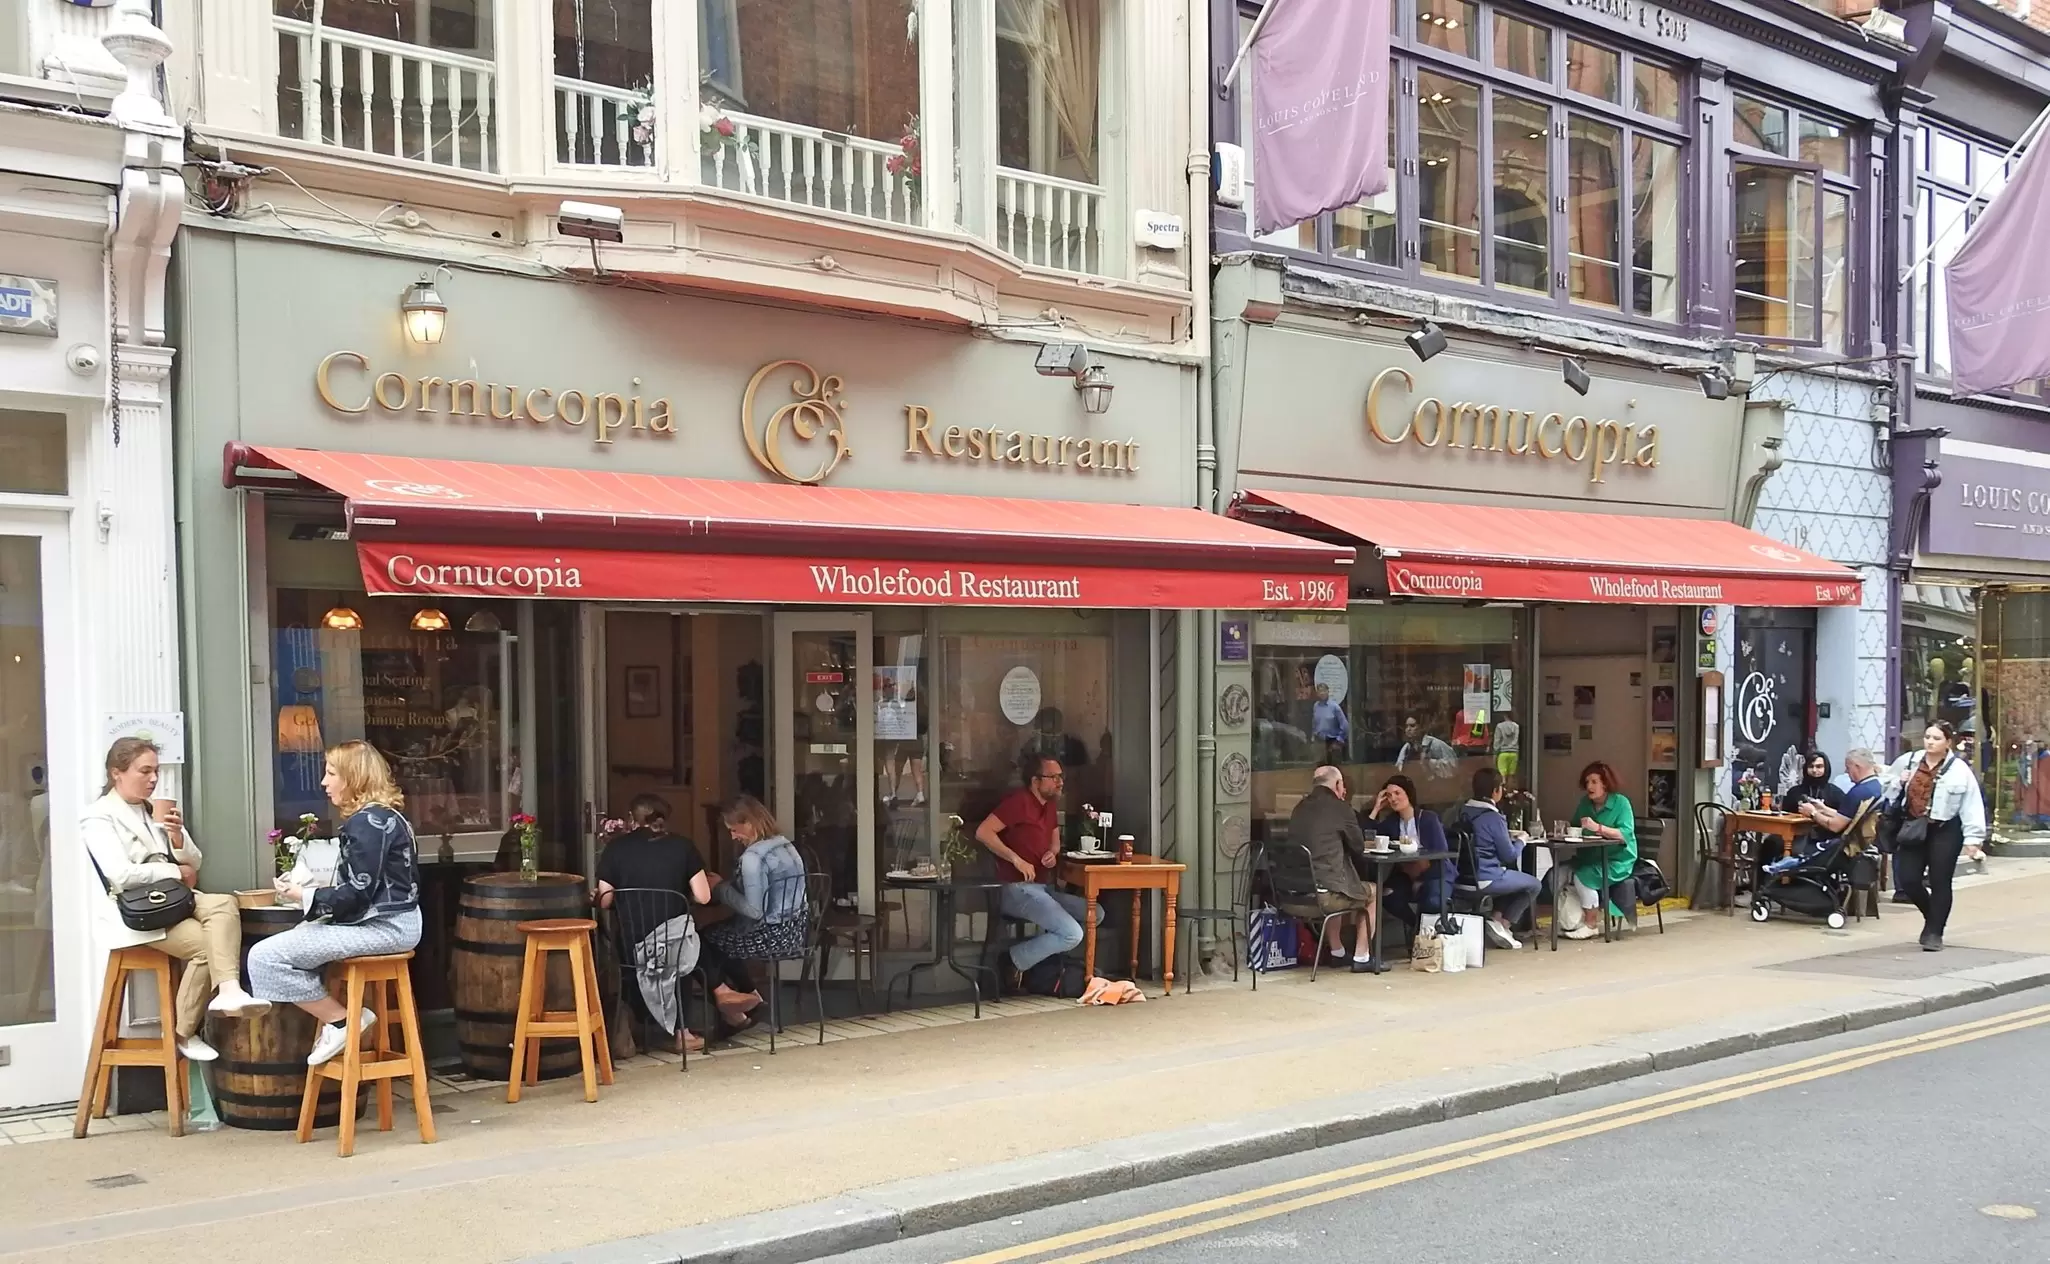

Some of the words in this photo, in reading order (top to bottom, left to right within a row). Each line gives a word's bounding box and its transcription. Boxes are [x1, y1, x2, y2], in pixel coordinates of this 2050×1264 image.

[1259, 106, 1299, 129] LOUIS
[1147, 221, 1180, 233] Spectra
[0, 292, 32, 313] ADT
[316, 350, 679, 444] Cornucopia
[904, 403, 1141, 472] Restaurant
[1366, 366, 1661, 484] Cornucopia
[1961, 483, 2022, 512] LOUIS
[1793, 525, 1808, 549] 19
[2022, 523, 2043, 535] AND
[387, 555, 582, 596] Cornucopia
[809, 566, 953, 597] Wholefood
[959, 571, 1080, 598] Restaurant
[1262, 579, 1294, 601] Est.
[1299, 580, 1335, 602] 1986
[1397, 568, 1483, 596] Cornucopia
[1589, 576, 1658, 598] Wholefood
[1662, 582, 1723, 600] Restaurant
[383, 672, 431, 690] Seating
[408, 712, 452, 726] Rooms
